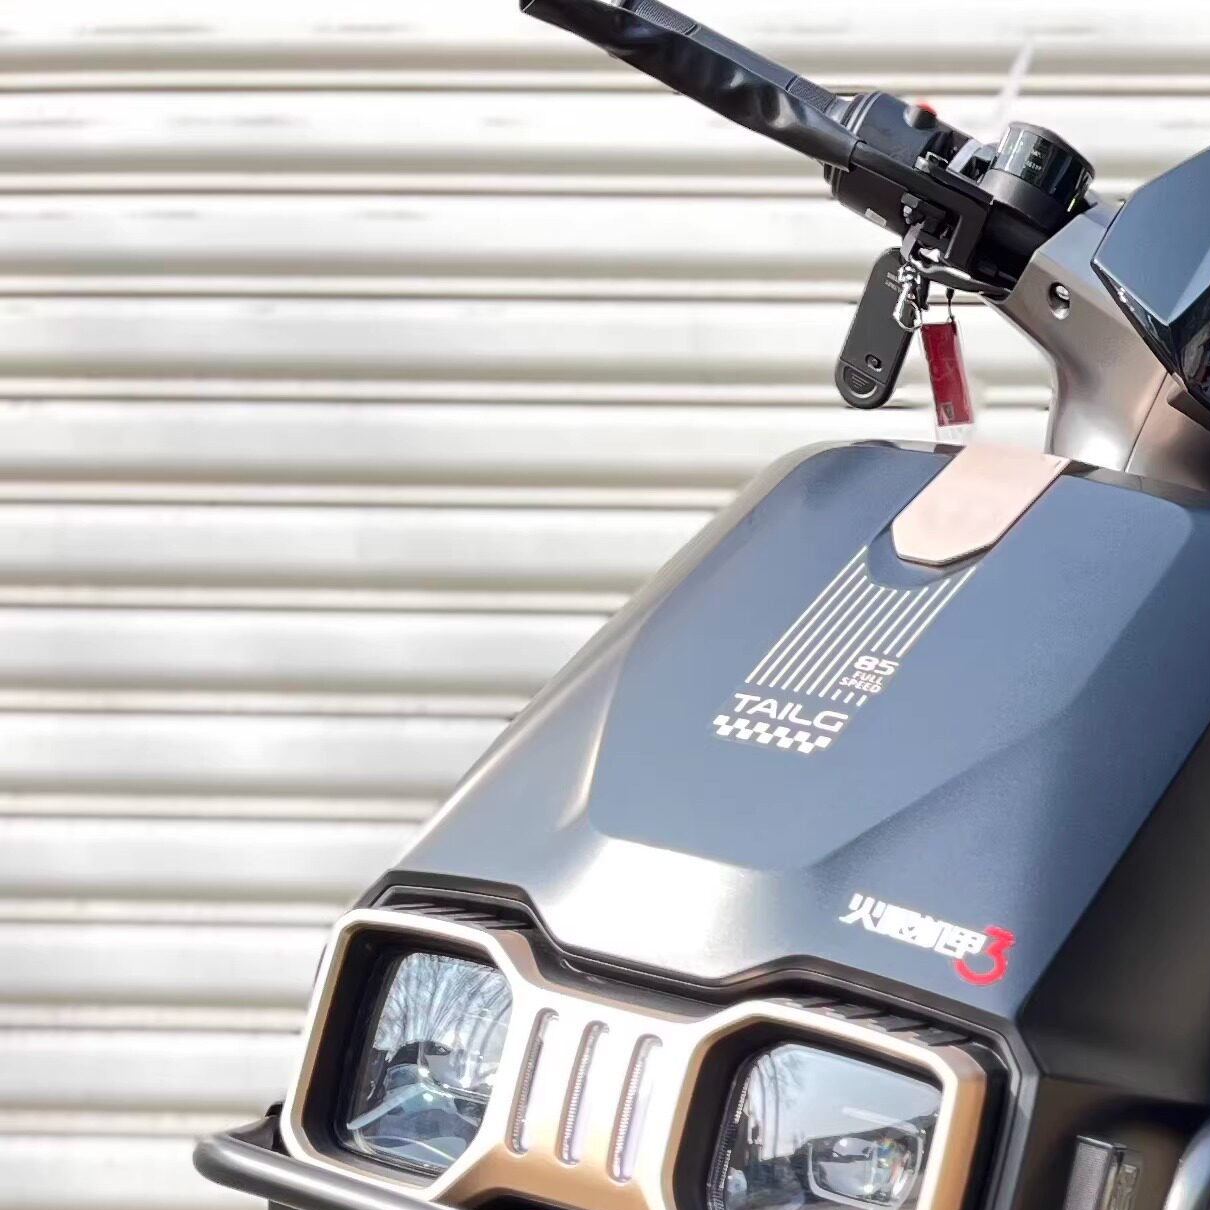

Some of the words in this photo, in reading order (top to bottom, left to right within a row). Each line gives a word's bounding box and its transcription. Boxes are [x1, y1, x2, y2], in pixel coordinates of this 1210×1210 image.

[854, 655, 899, 675] 85
[839, 676, 882, 693] SPEED
[852, 671, 883, 686] FULL
[734, 692, 849, 733] TAILG
